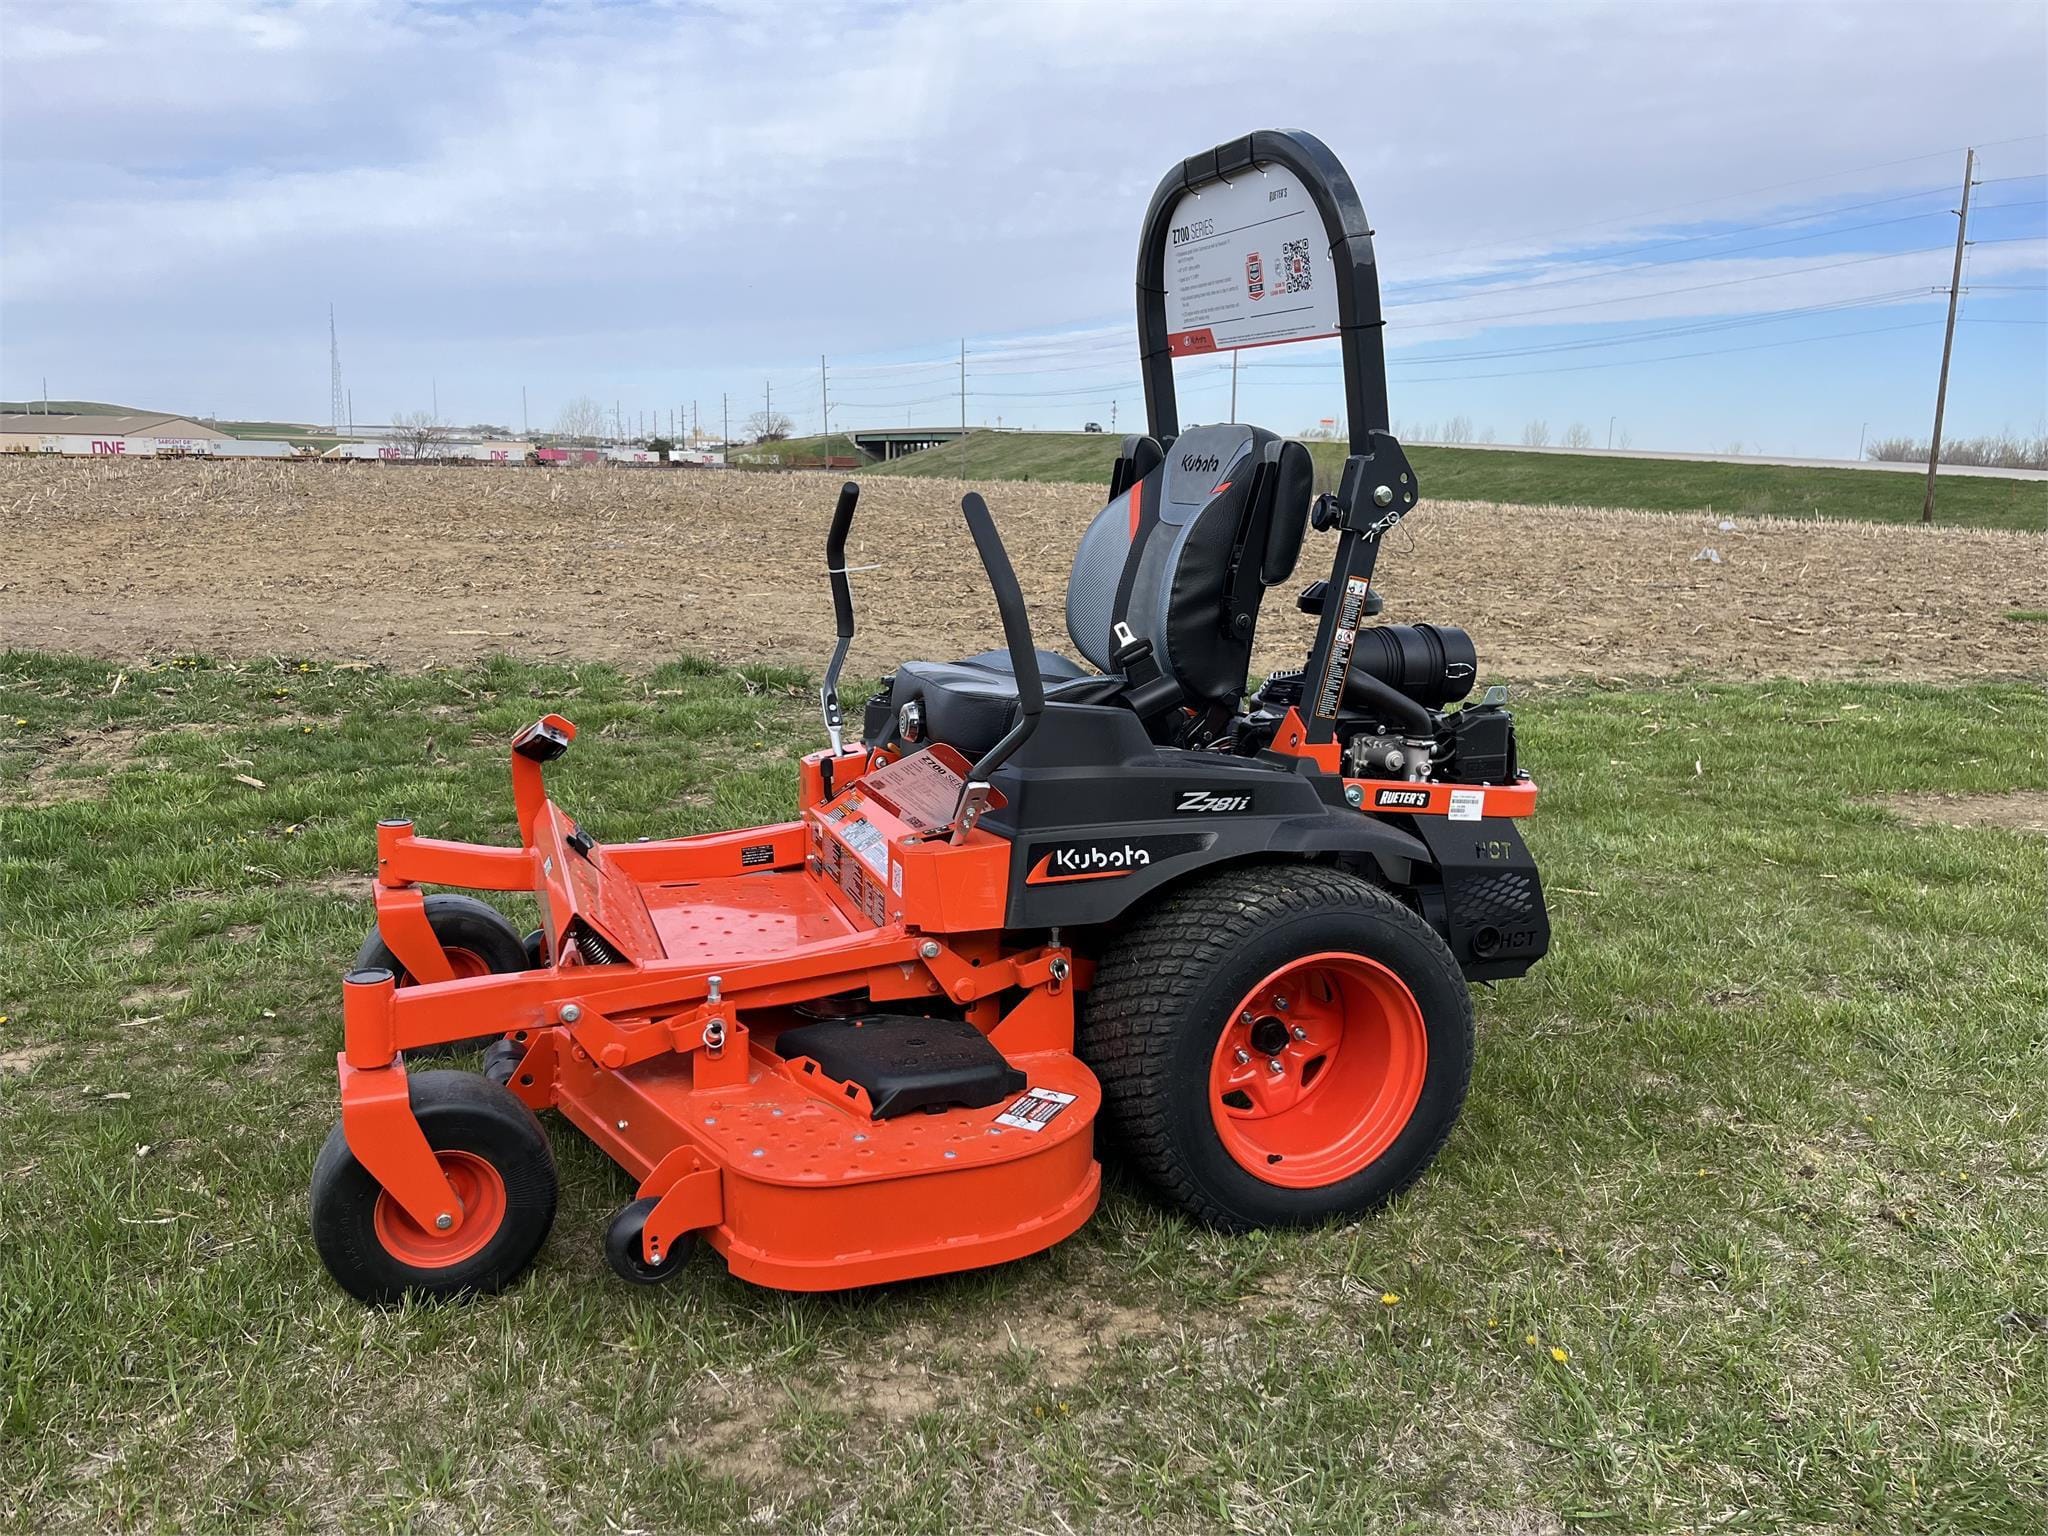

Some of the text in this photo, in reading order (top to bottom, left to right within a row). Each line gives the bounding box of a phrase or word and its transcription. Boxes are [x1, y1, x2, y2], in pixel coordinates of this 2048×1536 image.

[1172, 218, 1214, 244] Z700 SERIES
[91, 441, 125, 454] ONE
[378, 448, 401, 459] ONE
[490, 451, 509, 461] ONE
[1181, 453, 1219, 472] Kubota
[922, 755, 946, 775] Z700
[1176, 791, 1251, 812] Z781i
[1379, 790, 1426, 806] RUETER'S
[1057, 845, 1150, 870] Kubota
[1475, 841, 1511, 860] HOT
[1499, 930, 1537, 948] HOT
